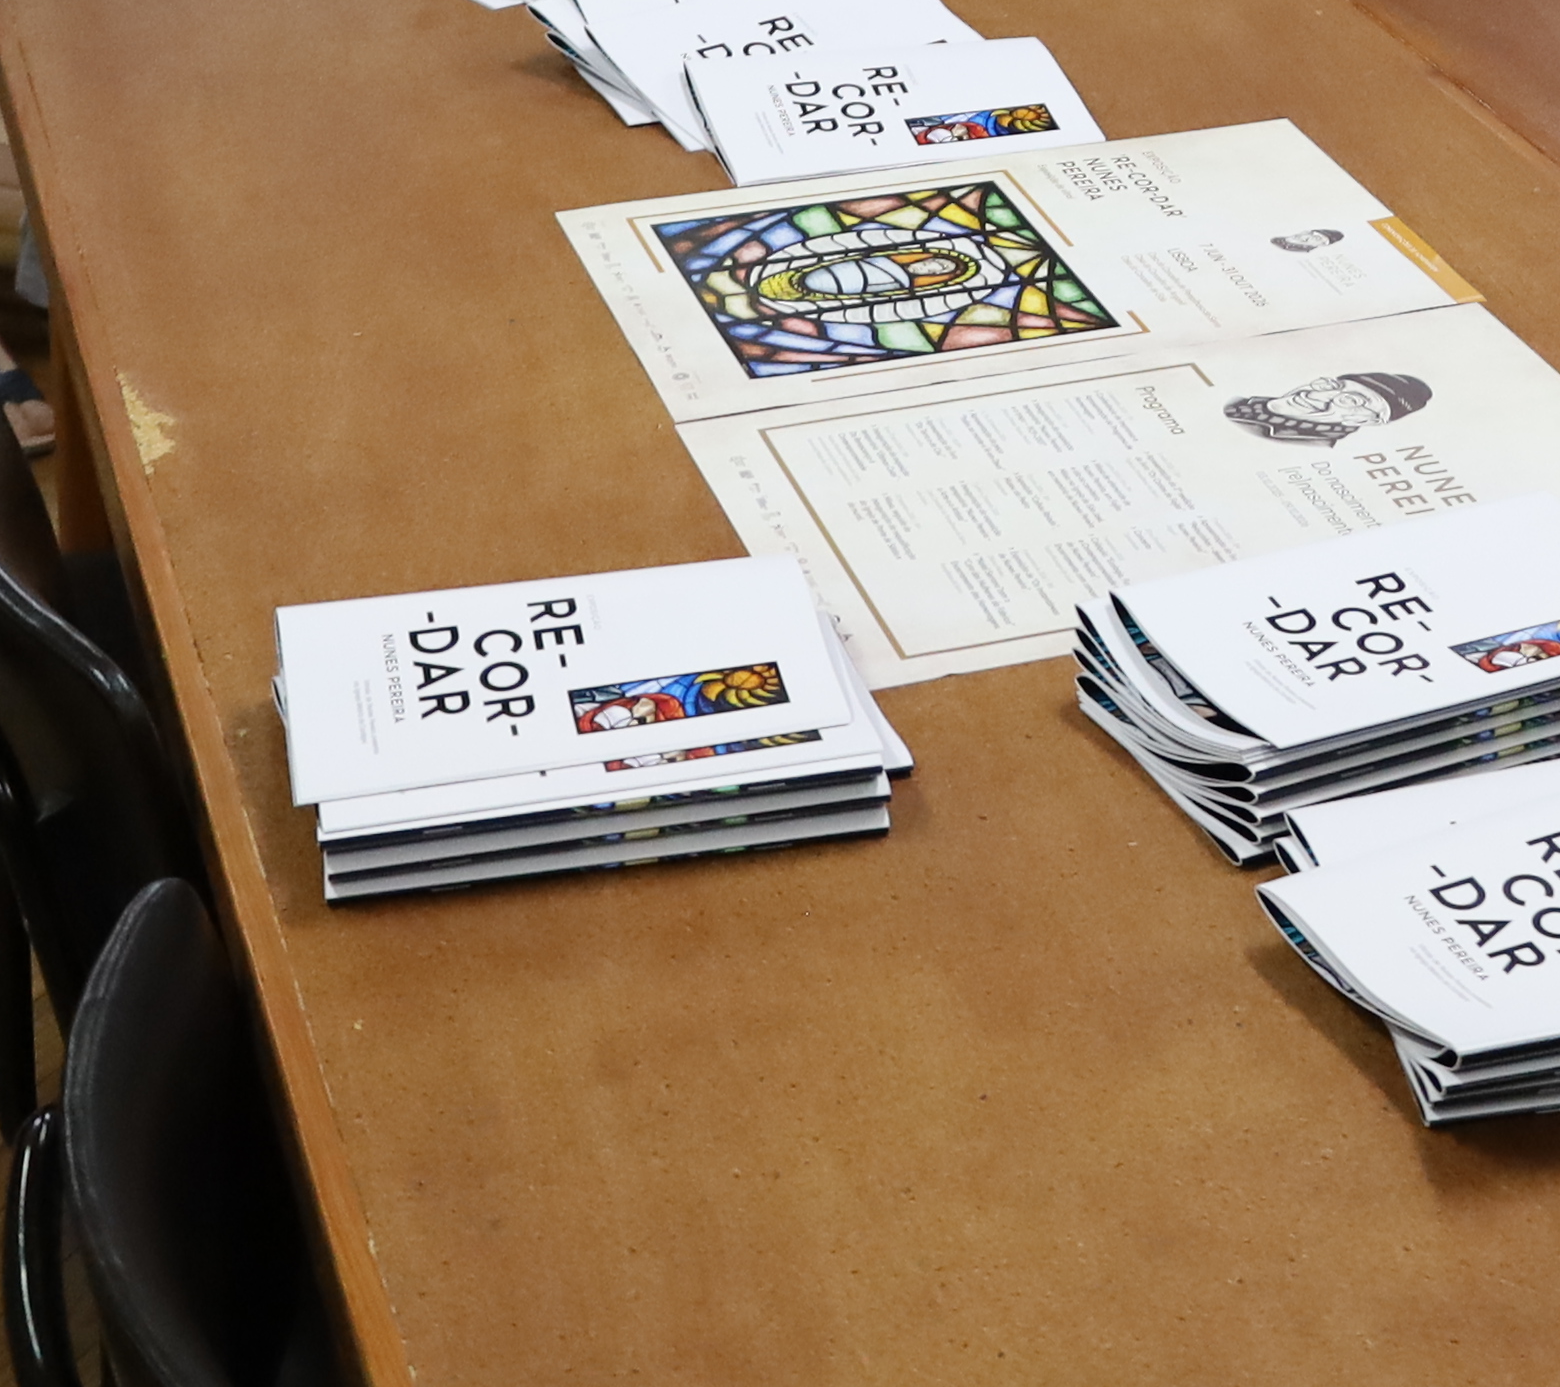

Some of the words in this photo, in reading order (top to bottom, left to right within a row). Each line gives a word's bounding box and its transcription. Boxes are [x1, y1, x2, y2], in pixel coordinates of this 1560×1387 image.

[758, 16, 814, 53] RE
[785, 71, 839, 134] -DAR
[831, 83, 885, 146] COR-
[862, 66, 909, 106] RE-
[1057, 160, 1104, 202] PEREIRA
[1083, 157, 1128, 192] NUNES
[1136, 385, 1186, 435] Programa
[1310, 460, 1332, 477] Do
[1325, 477, 1382, 528] nasciment
[1353, 452, 1435, 516] PEREI
[1395, 445, 1477, 508] NUNE
[527, 597, 585, 668] RE-
[1355, 572, 1433, 631] RE-
[382, 633, 398, 674] NUNES
[408, 611, 471, 719] -DAR
[1243, 620, 1278, 653] NUNES
[1276, 654, 1316, 688] PEREIRA
[1265, 596, 1367, 681] -DAR
[1331, 607, 1434, 683] COR-
[389, 676, 405, 724] PEREIRA
[473, 629, 535, 736] COR-
[1404, 894, 1445, 936] NUNES
[1441, 937, 1489, 982] PEREIRA
[1428, 864, 1545, 974] -DAR
